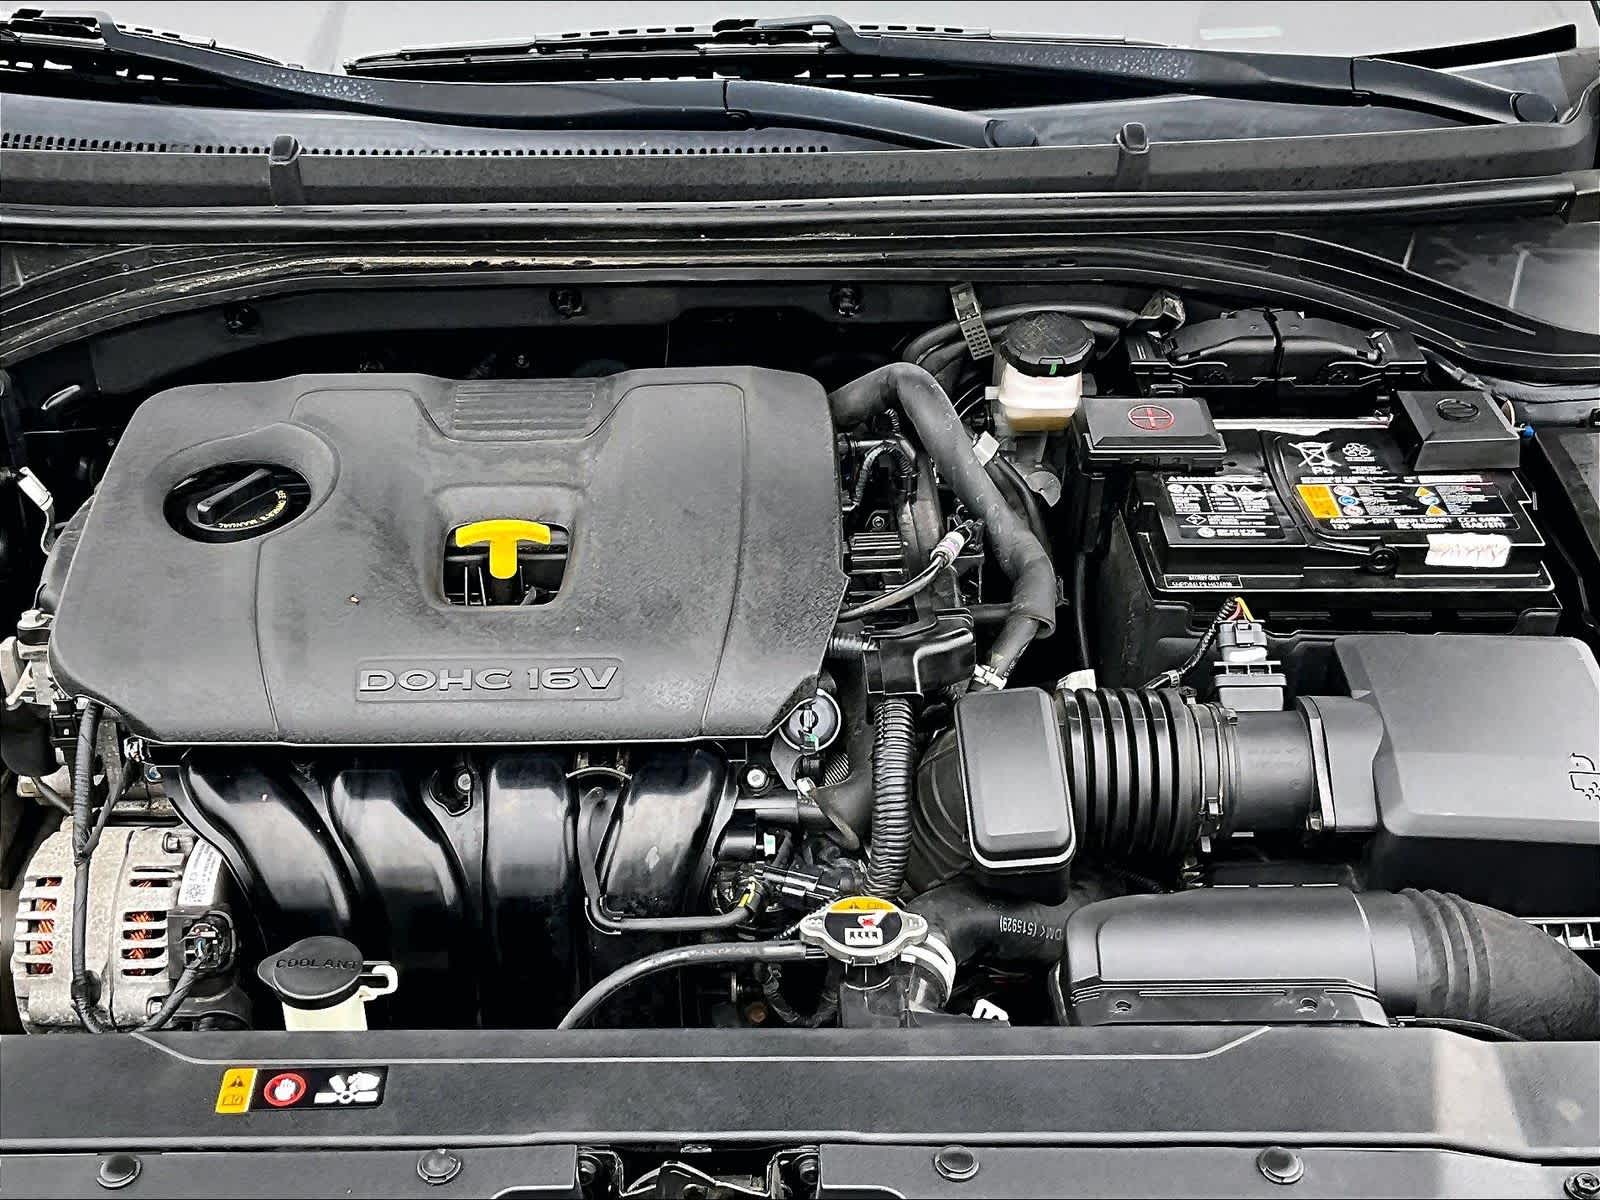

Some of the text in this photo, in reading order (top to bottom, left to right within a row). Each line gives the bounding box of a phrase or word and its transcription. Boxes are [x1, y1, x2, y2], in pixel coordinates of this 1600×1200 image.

[1312, 466, 1335, 475] Pb
[218, 519, 258, 529] MANUAL
[359, 666, 618, 691] DOHC 16V
[999, 915, 1037, 938] (515929)
[276, 959, 359, 970] COOLANT
